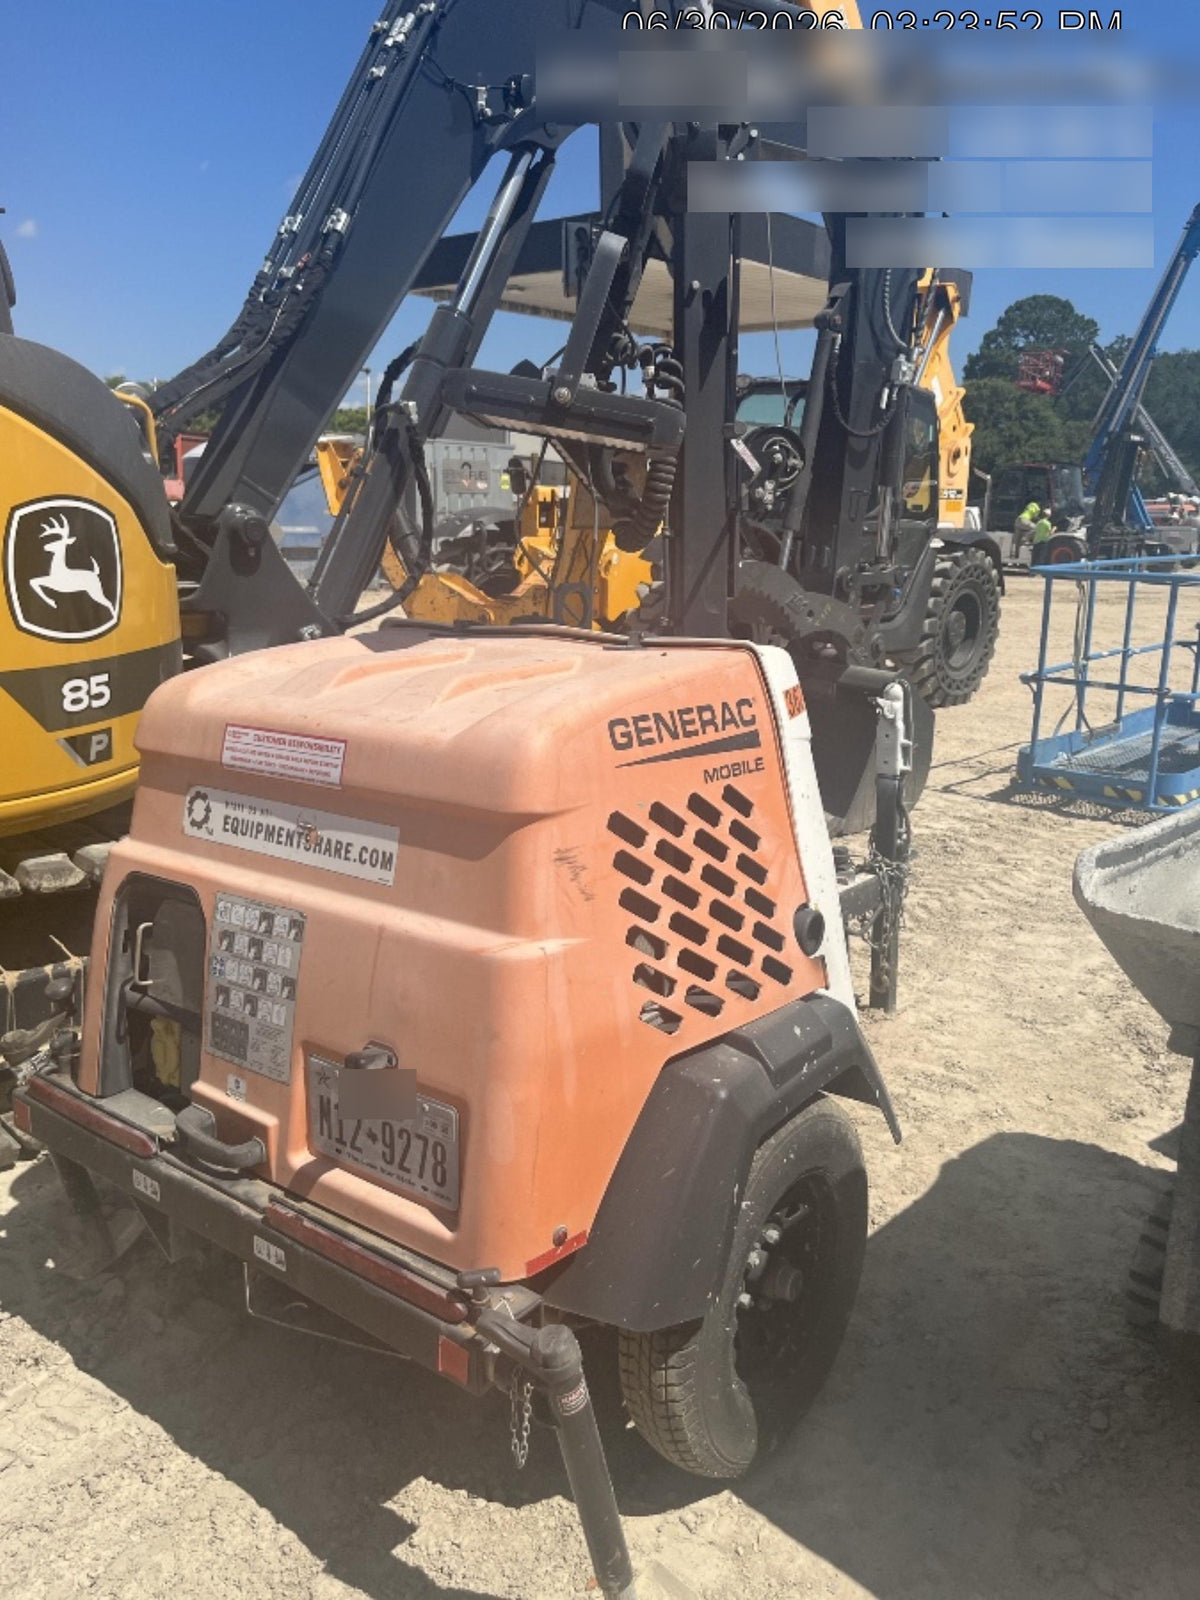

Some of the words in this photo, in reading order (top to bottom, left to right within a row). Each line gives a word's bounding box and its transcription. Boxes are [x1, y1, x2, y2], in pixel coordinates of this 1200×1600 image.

[61, 673, 111, 712] 85
[607, 698, 757, 751] GENERAC
[90, 733, 109, 762] P
[703, 757, 765, 784] MOBILE
[381, 1120, 448, 1188] 9278
